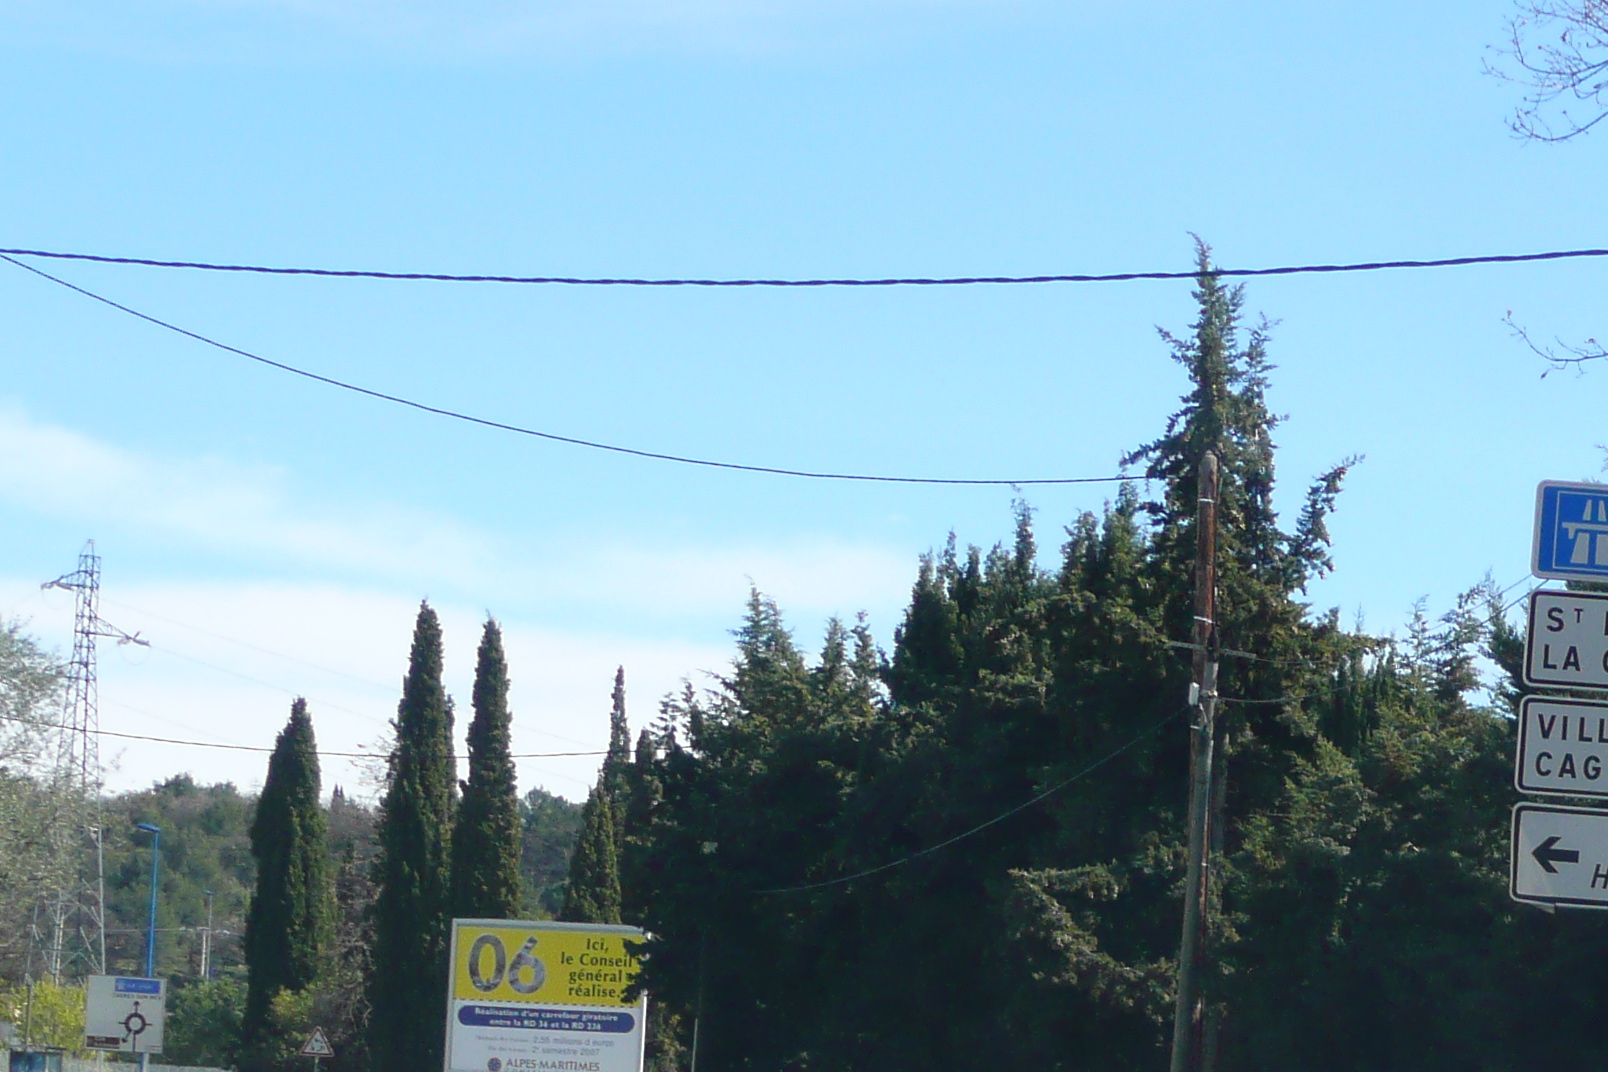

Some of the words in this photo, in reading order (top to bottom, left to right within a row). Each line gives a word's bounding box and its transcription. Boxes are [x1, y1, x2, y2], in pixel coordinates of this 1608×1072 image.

[1542, 643, 1581, 672] LA
[468, 932, 547, 995] 06
[560, 951, 574, 965] le
[579, 951, 633, 968] Conseil
[568, 968, 623, 985] général
[506, 1057, 600, 1072] ALPES-MARITIMES
